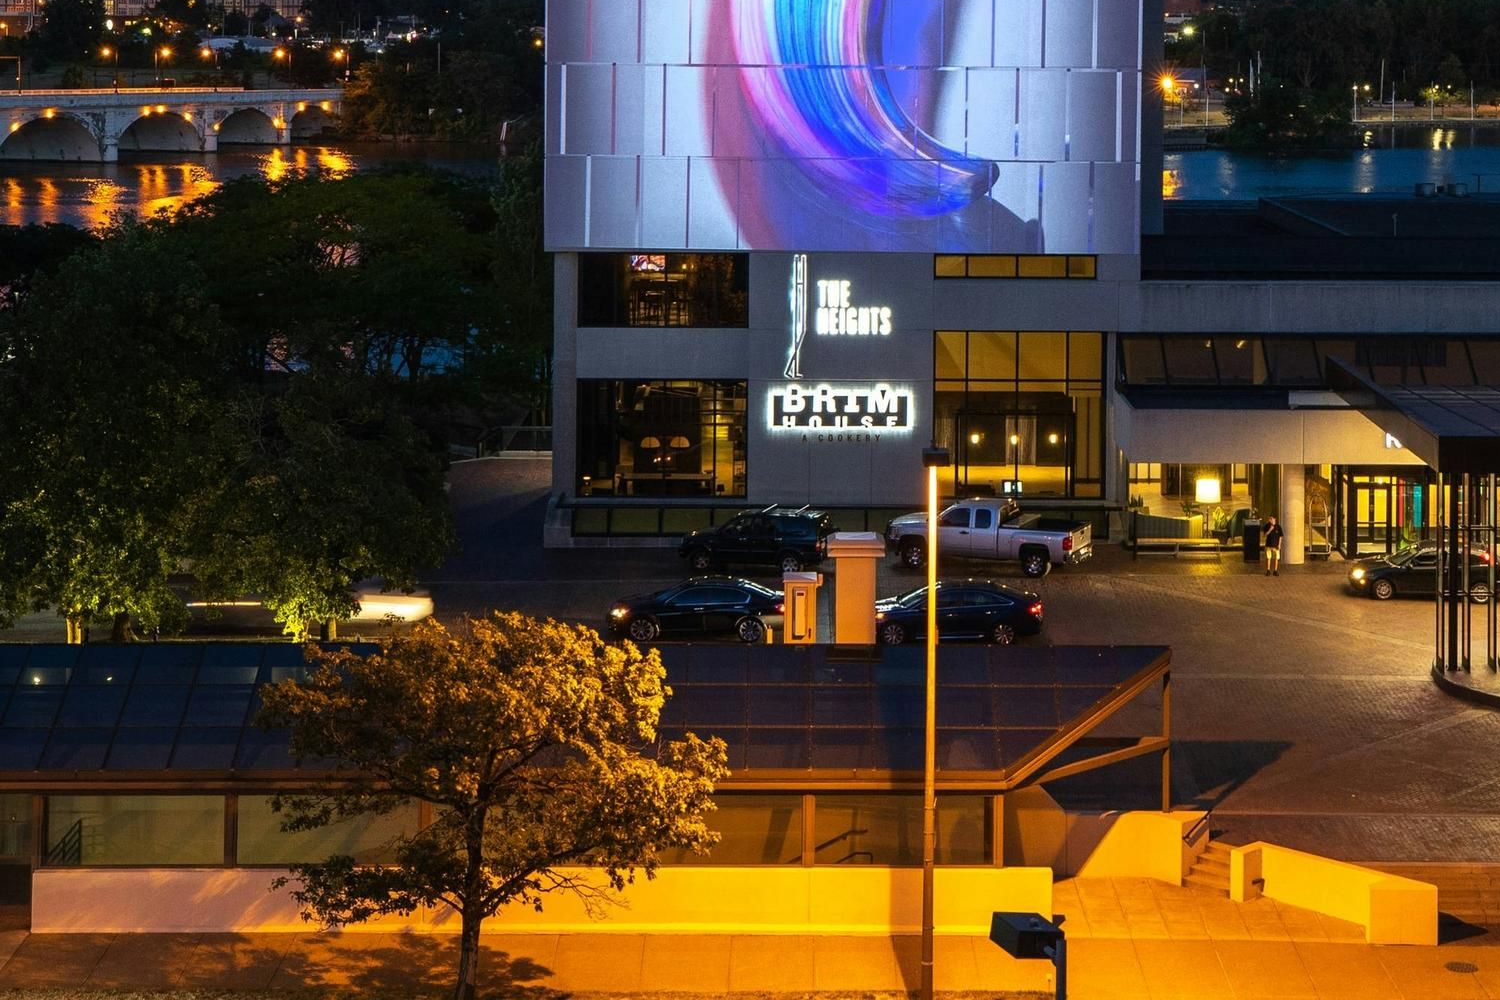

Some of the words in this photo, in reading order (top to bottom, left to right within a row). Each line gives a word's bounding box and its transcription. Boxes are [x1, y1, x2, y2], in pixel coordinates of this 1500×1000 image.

[816, 279, 851, 308] THE
[815, 306, 892, 336] HEIGHTS
[782, 383, 899, 413] BRIM
[782, 415, 899, 428] HOUSE
[802, 434, 808, 442] A
[818, 434, 881, 442] COOKERY
